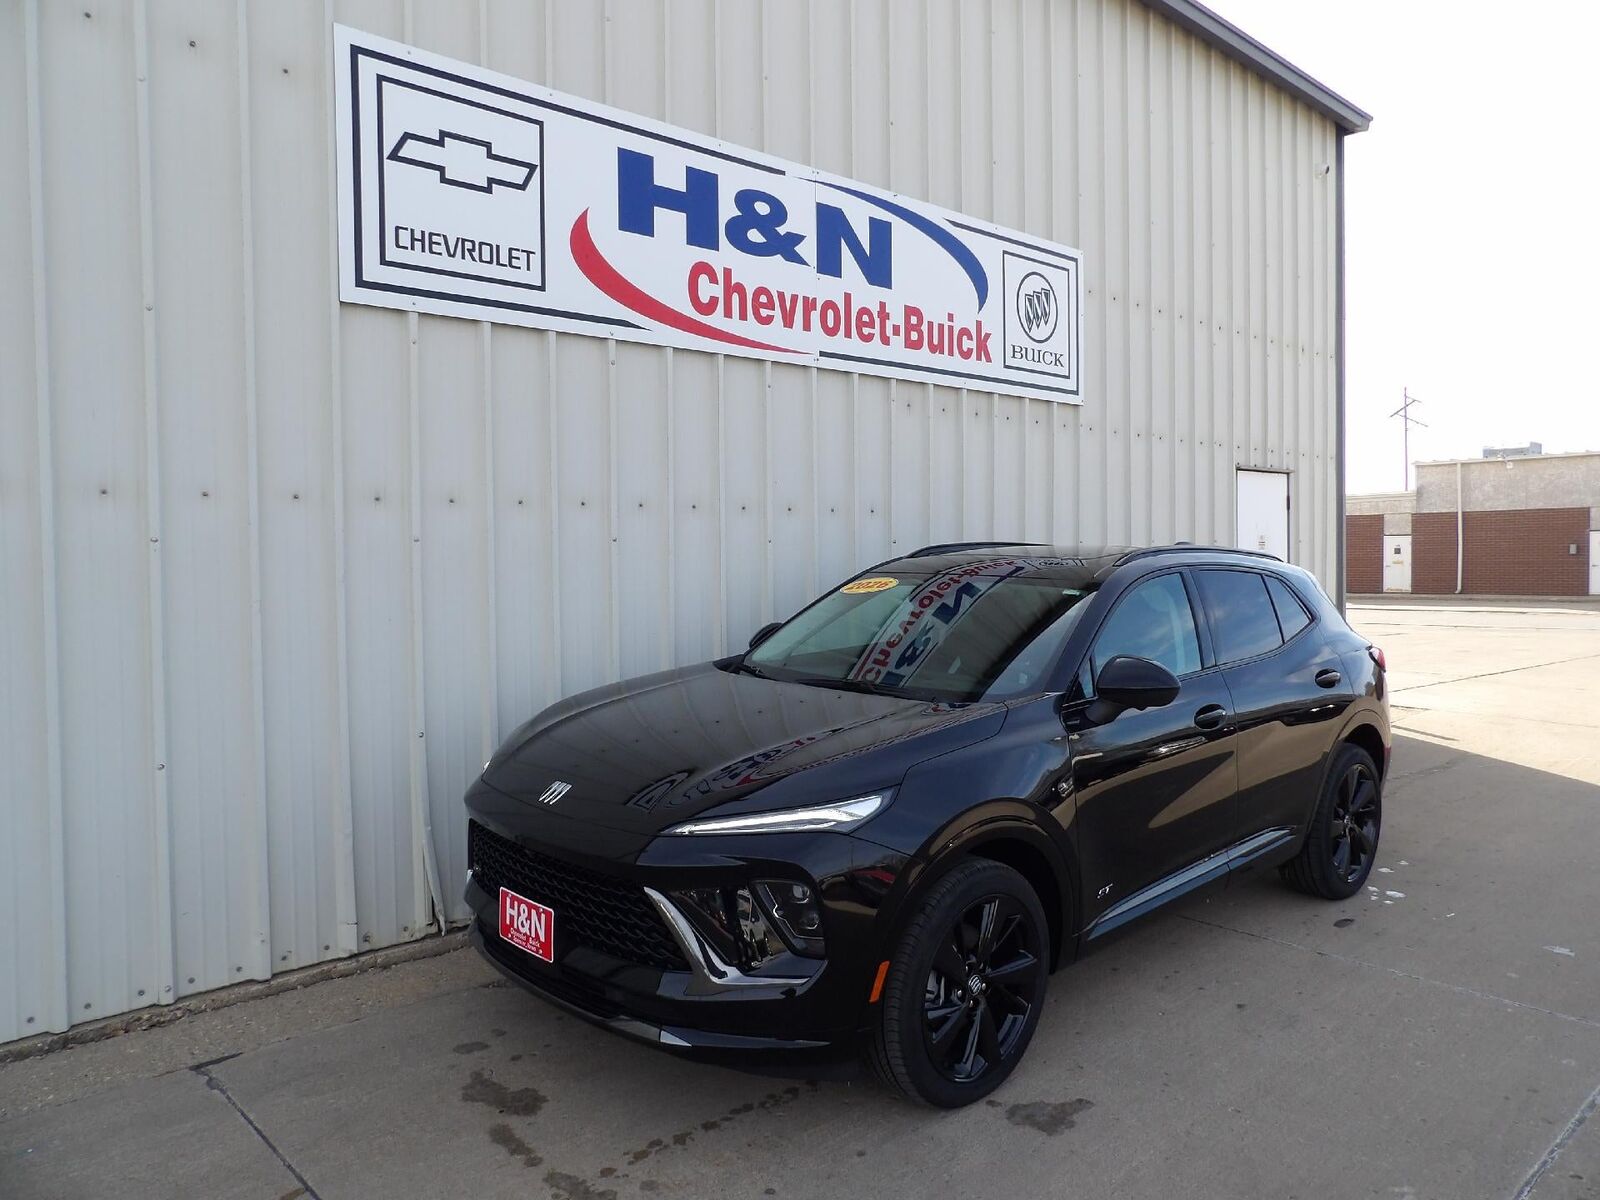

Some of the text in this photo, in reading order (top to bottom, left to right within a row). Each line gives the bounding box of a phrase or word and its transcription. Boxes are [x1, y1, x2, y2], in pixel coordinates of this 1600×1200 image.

[616, 146, 893, 290] H&N
[394, 225, 536, 271] CHEVROLET
[687, 260, 993, 363] Chevrolet-Buick
[1010, 343, 1065, 368] BUICK
[844, 578, 894, 592] 2026
[506, 896, 546, 942] H&N
